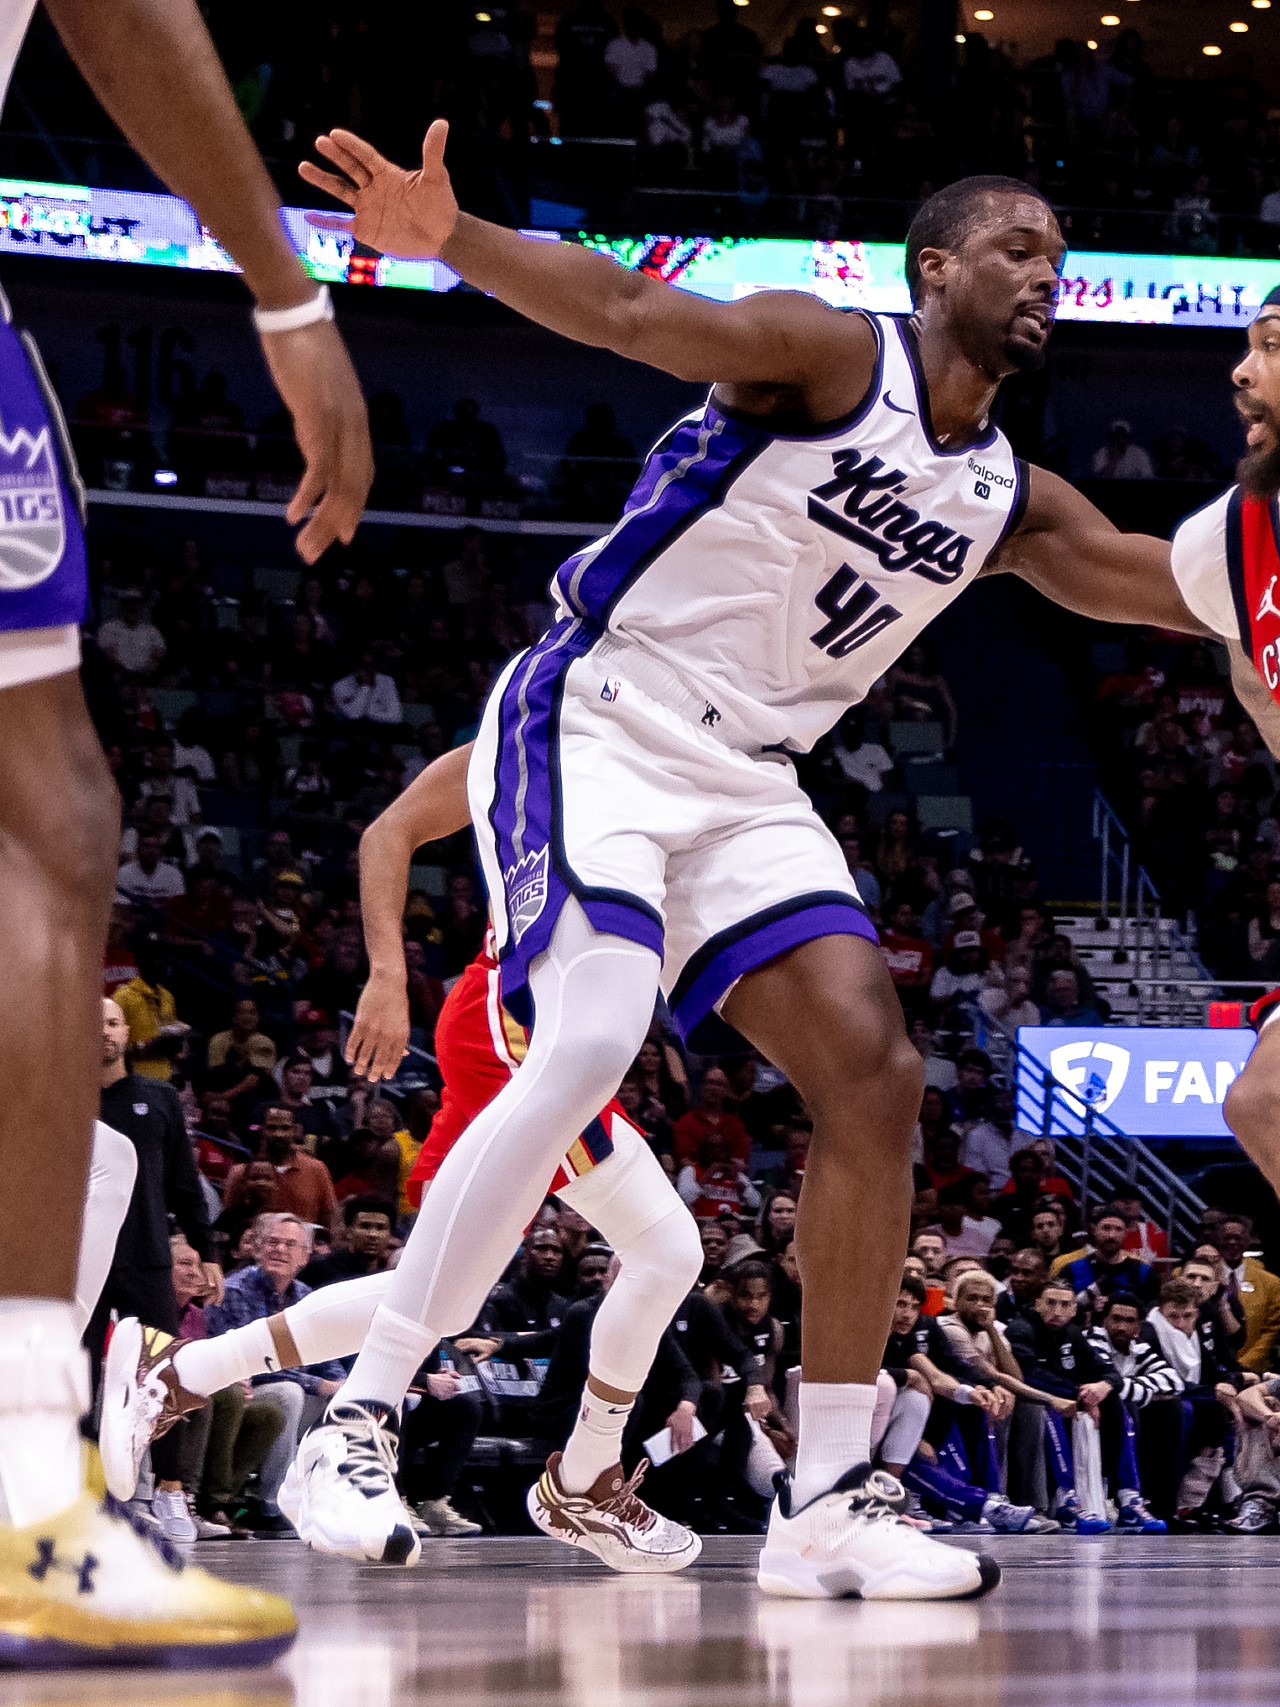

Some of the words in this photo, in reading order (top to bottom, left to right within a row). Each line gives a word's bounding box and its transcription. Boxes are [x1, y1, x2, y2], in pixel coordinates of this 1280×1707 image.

[97, 322, 195, 406] 116
[808, 448, 975, 585] Kings
[809, 562, 903, 660] 40
